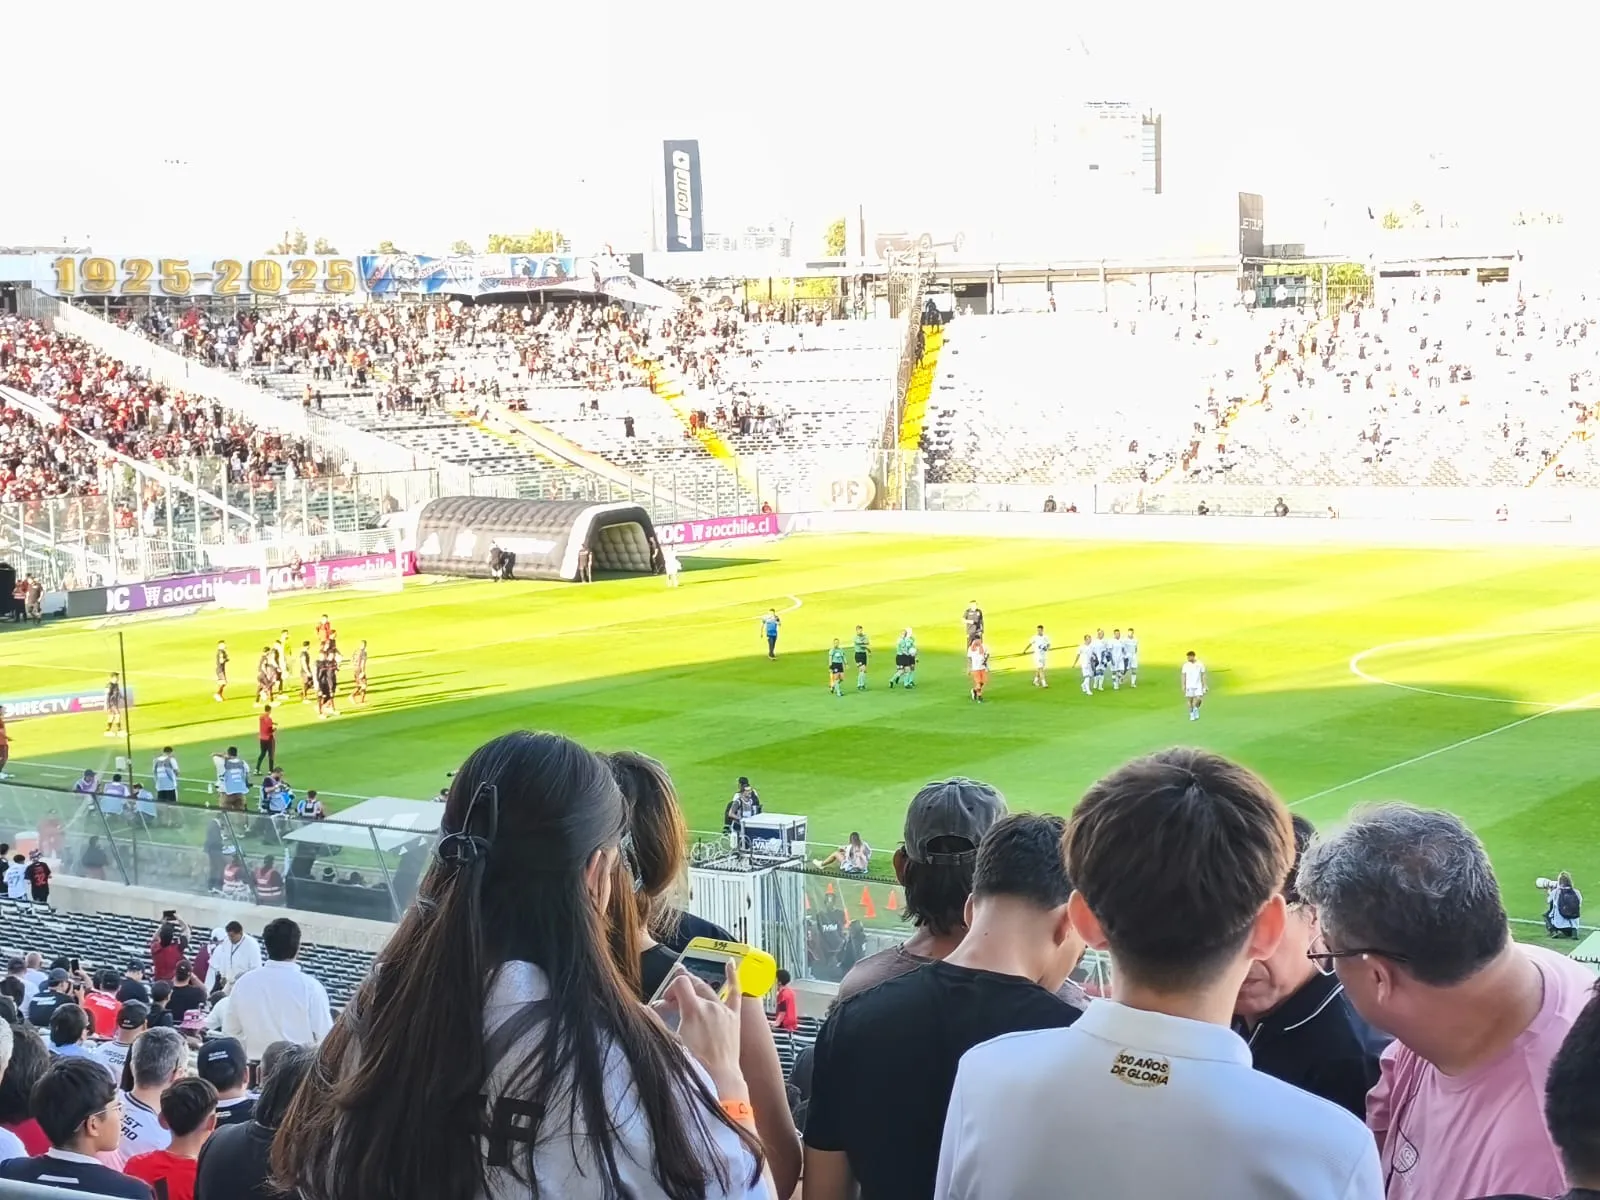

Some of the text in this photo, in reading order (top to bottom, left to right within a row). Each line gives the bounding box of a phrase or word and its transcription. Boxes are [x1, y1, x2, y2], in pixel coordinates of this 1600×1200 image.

[53, 257, 357, 295] 1925-2025
[705, 517, 770, 538] aocchile.cl
[4, 697, 71, 718] DIRECTV
[1119, 1055, 1169, 1073] 100 AÑOS
[1110, 1065, 1169, 1085] DE GLORIA
